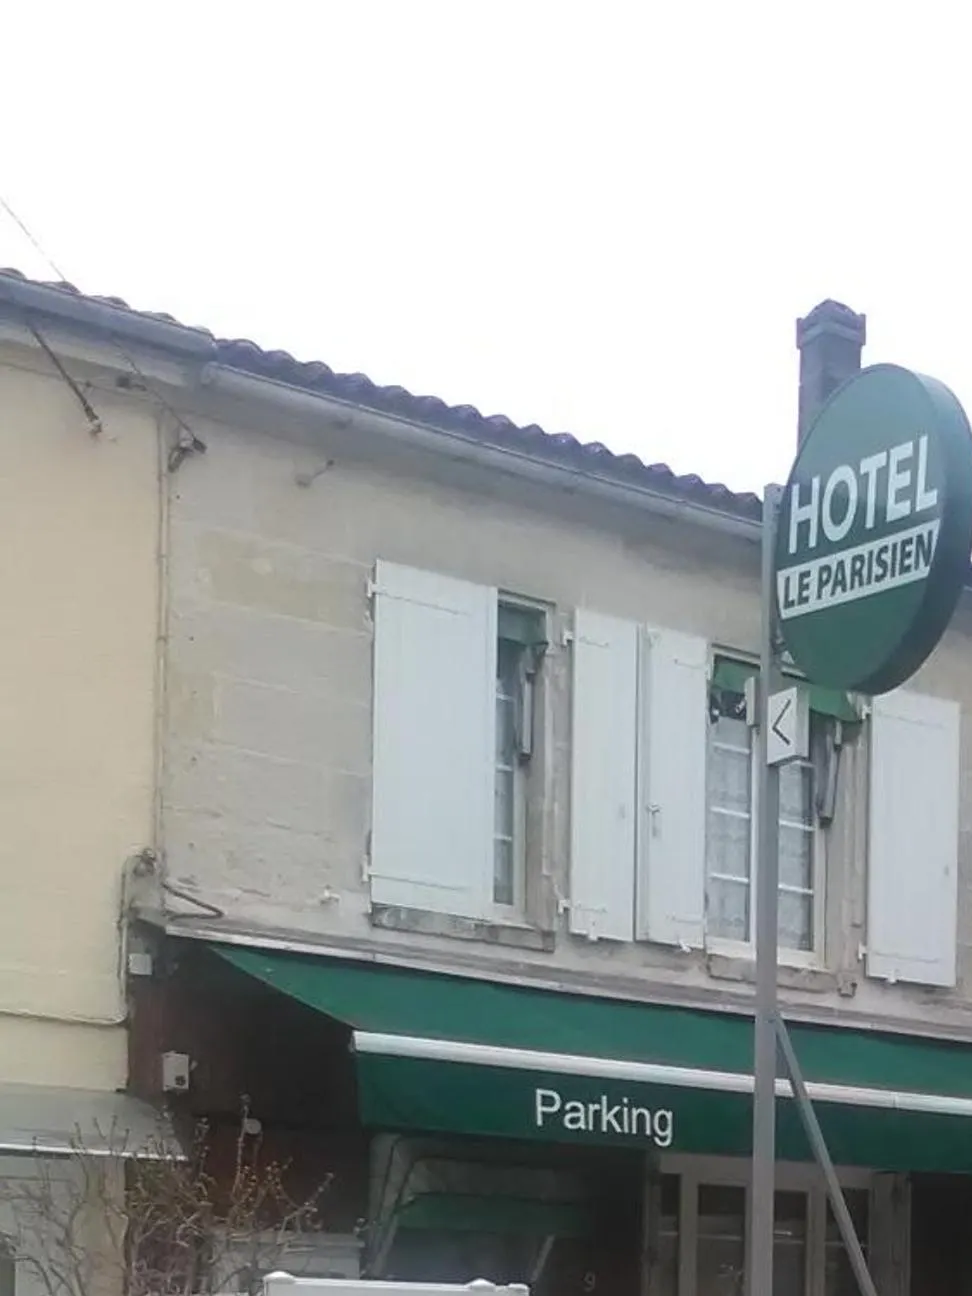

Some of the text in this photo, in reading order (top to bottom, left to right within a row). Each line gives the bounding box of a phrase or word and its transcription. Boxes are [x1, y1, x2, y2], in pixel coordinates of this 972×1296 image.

[788, 435, 938, 554] HOTEL
[783, 530, 934, 610] LE PARISIEN
[535, 1088, 673, 1147] Parking
